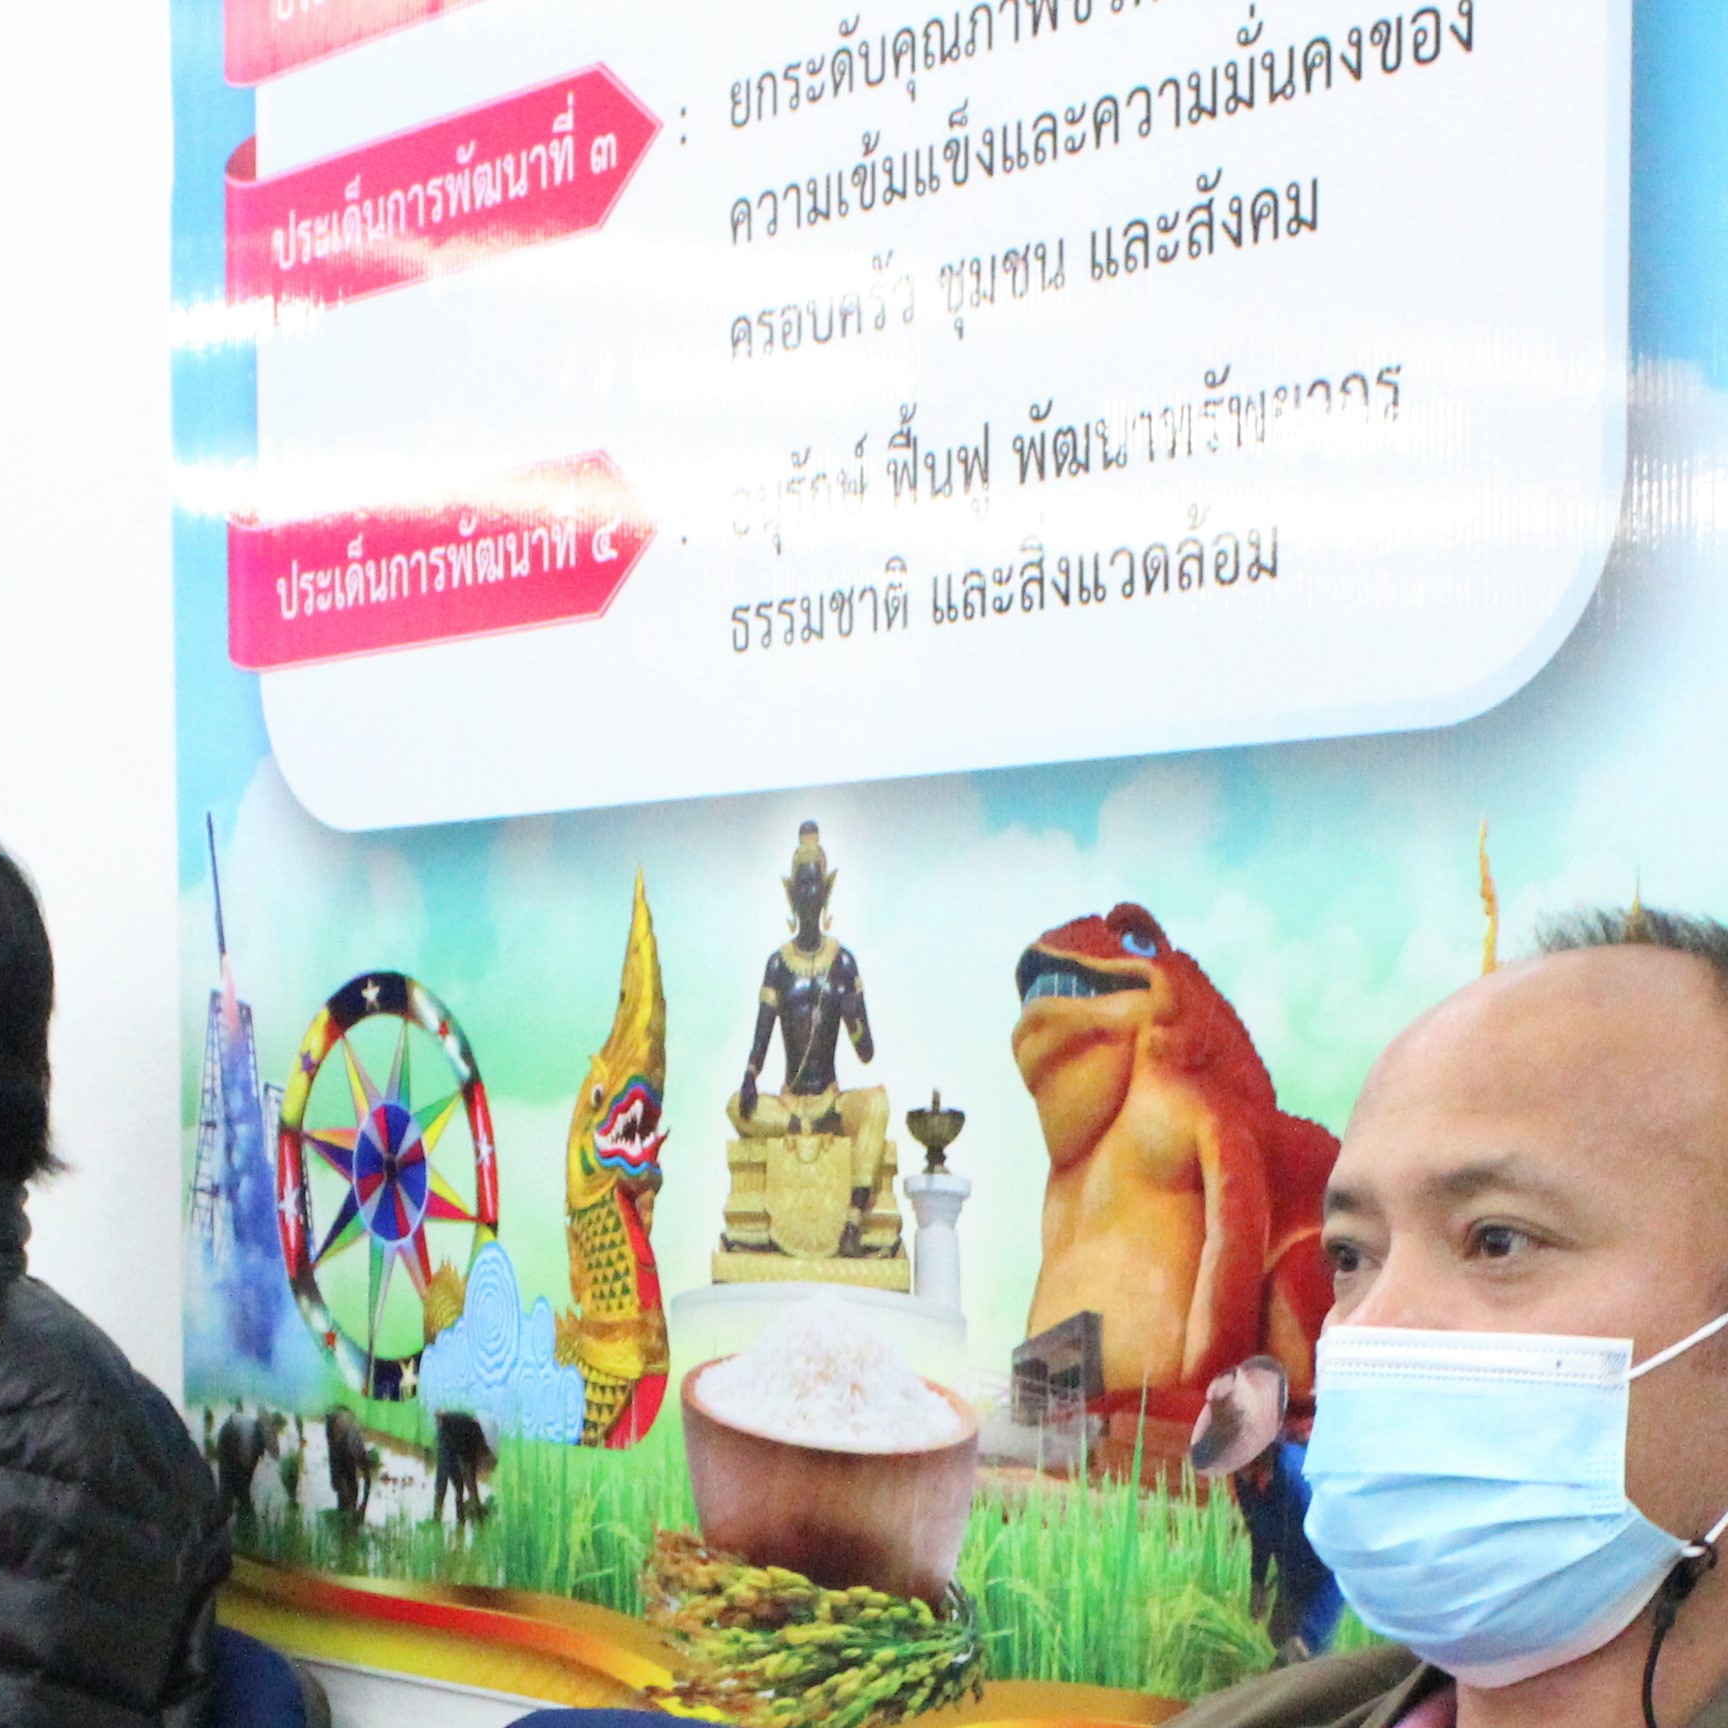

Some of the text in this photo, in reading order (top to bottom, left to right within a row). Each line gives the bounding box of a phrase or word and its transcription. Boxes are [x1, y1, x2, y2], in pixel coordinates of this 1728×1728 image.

[273, 92, 618, 271] ประเด็นการพัฒนาที่ ๓
[730, 0, 1474, 247] ความเข้มแข็งและความมั่นคงของ
[730, 168, 1319, 364] ครอบครัว ชุมชน และสังคม
[886, 402, 991, 523] ฟื้นฟู
[276, 506, 622, 620] ประเด็นการพัฒนาท ๔
[731, 556, 910, 654] ธรรมชาติ
